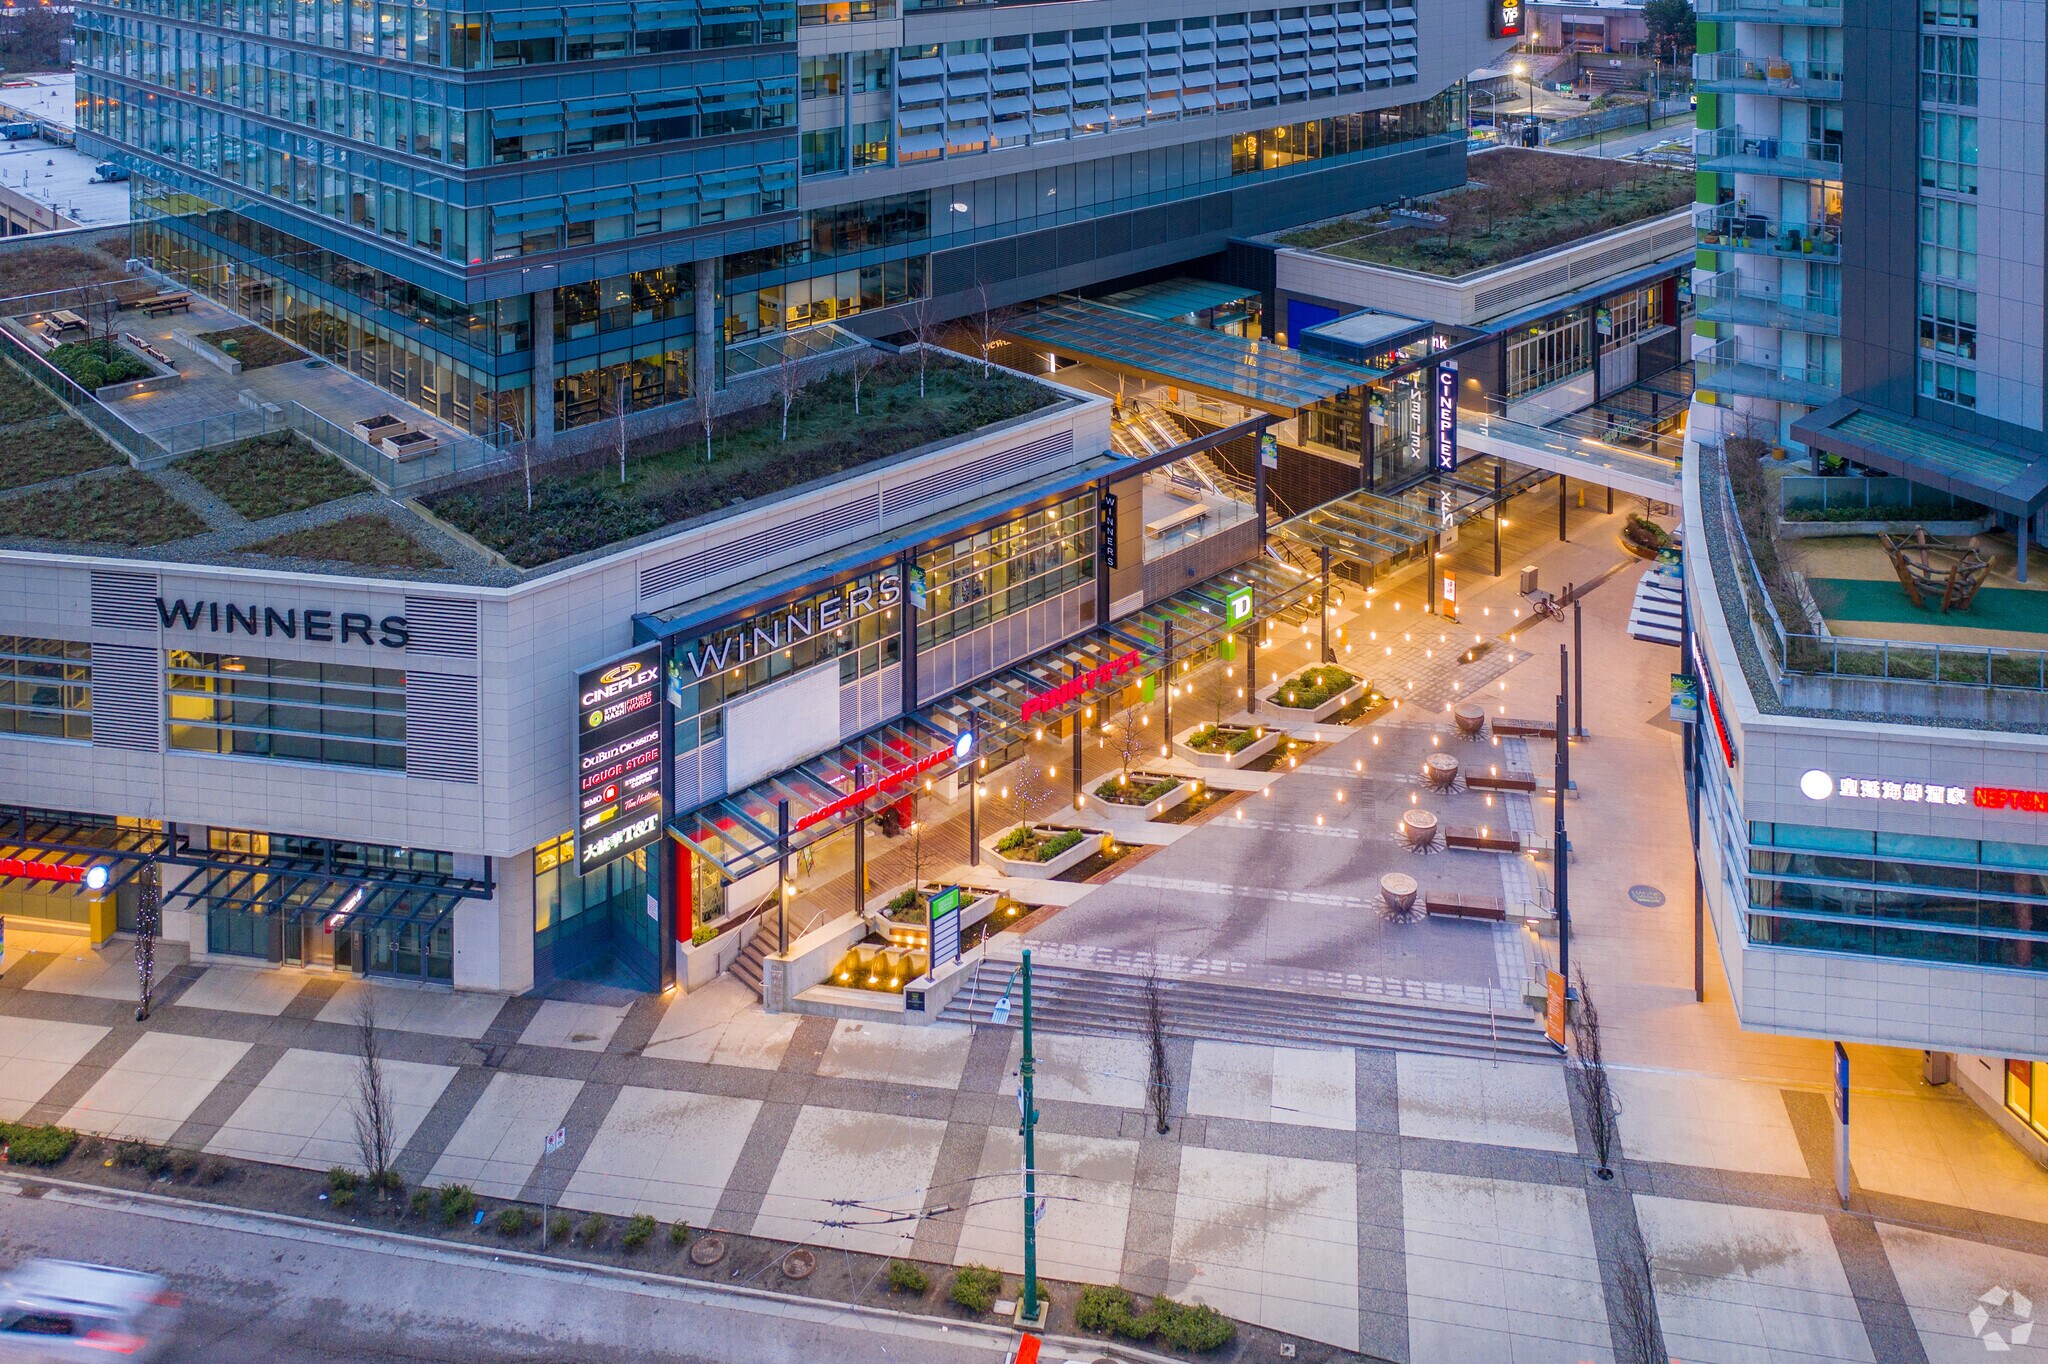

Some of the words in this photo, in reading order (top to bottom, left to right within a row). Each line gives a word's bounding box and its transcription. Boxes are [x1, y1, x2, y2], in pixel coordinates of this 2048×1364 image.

[1503, 9, 1518, 23] VIP
[1440, 373, 1452, 468] CINEPLEX
[1106, 497, 1115, 566] WINNERS
[1231, 595, 1251, 620] TD
[155, 597, 410, 648] WINNERS
[687, 576, 901, 678] WINNERS
[582, 667, 659, 706] CINEPLEX
[604, 702, 625, 716] STEVE
[604, 707, 625, 722] NASH
[627, 698, 652, 712] WORLD
[582, 764, 623, 790] LIQUOR
[626, 750, 659, 770] STORE
[583, 795, 602, 809] BMO
[1974, 786, 2048, 813] NEPTUN
[624, 814, 659, 843] T&T
